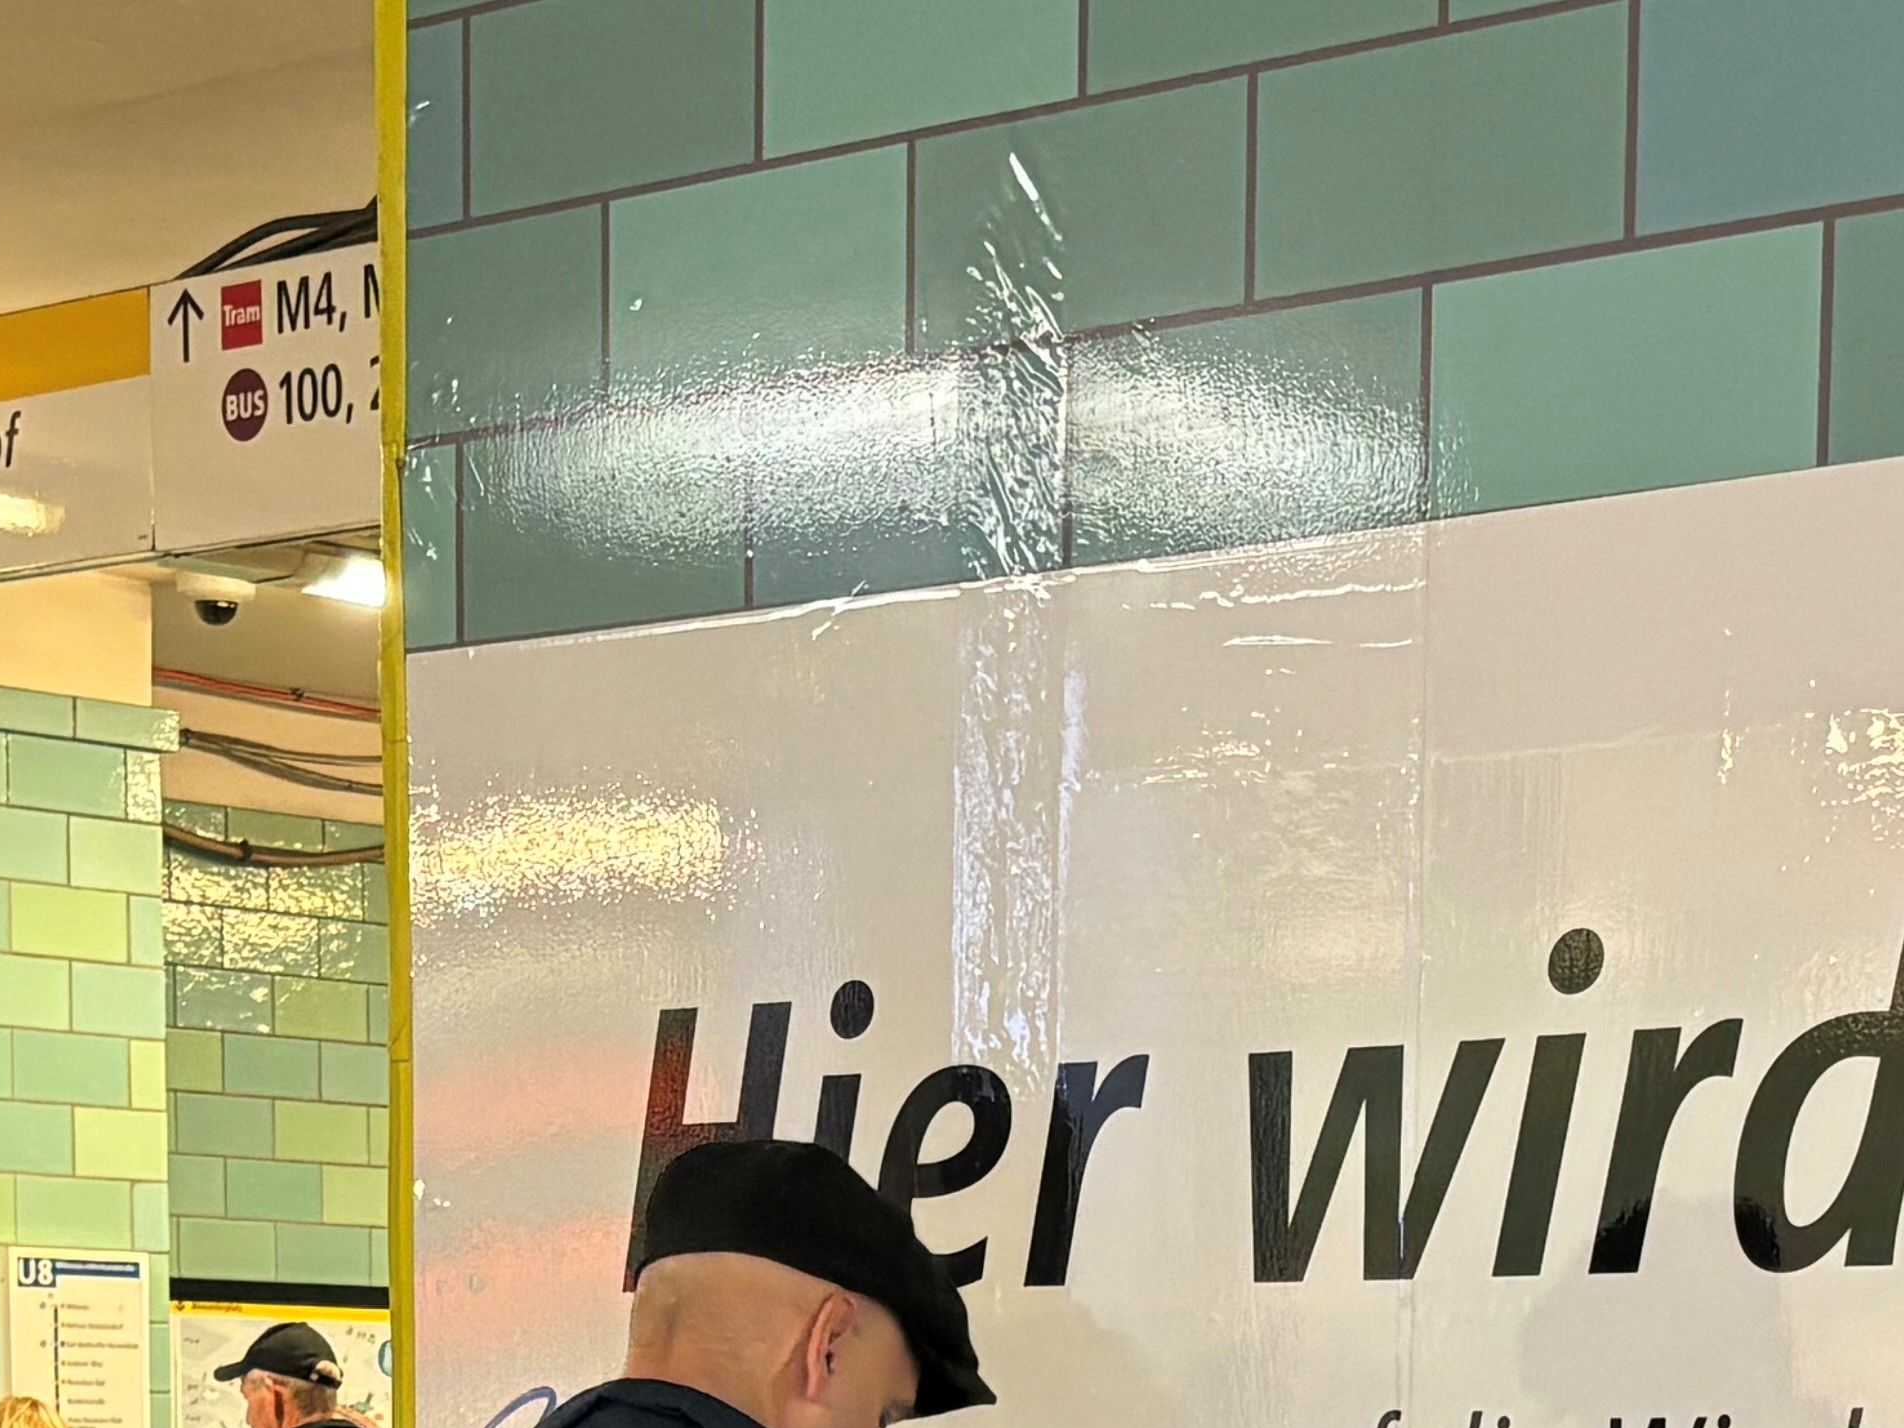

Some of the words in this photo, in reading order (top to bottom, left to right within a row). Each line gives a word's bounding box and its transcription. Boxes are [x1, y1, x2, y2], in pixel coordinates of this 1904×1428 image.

[224, 305, 260, 327] Tram
[277, 272, 347, 334] M4,
[226, 390, 265, 421] BUS
[279, 364, 353, 424] 100,
[622, 980, 1149, 1293] Hier
[18, 1259, 54, 1285] U8
